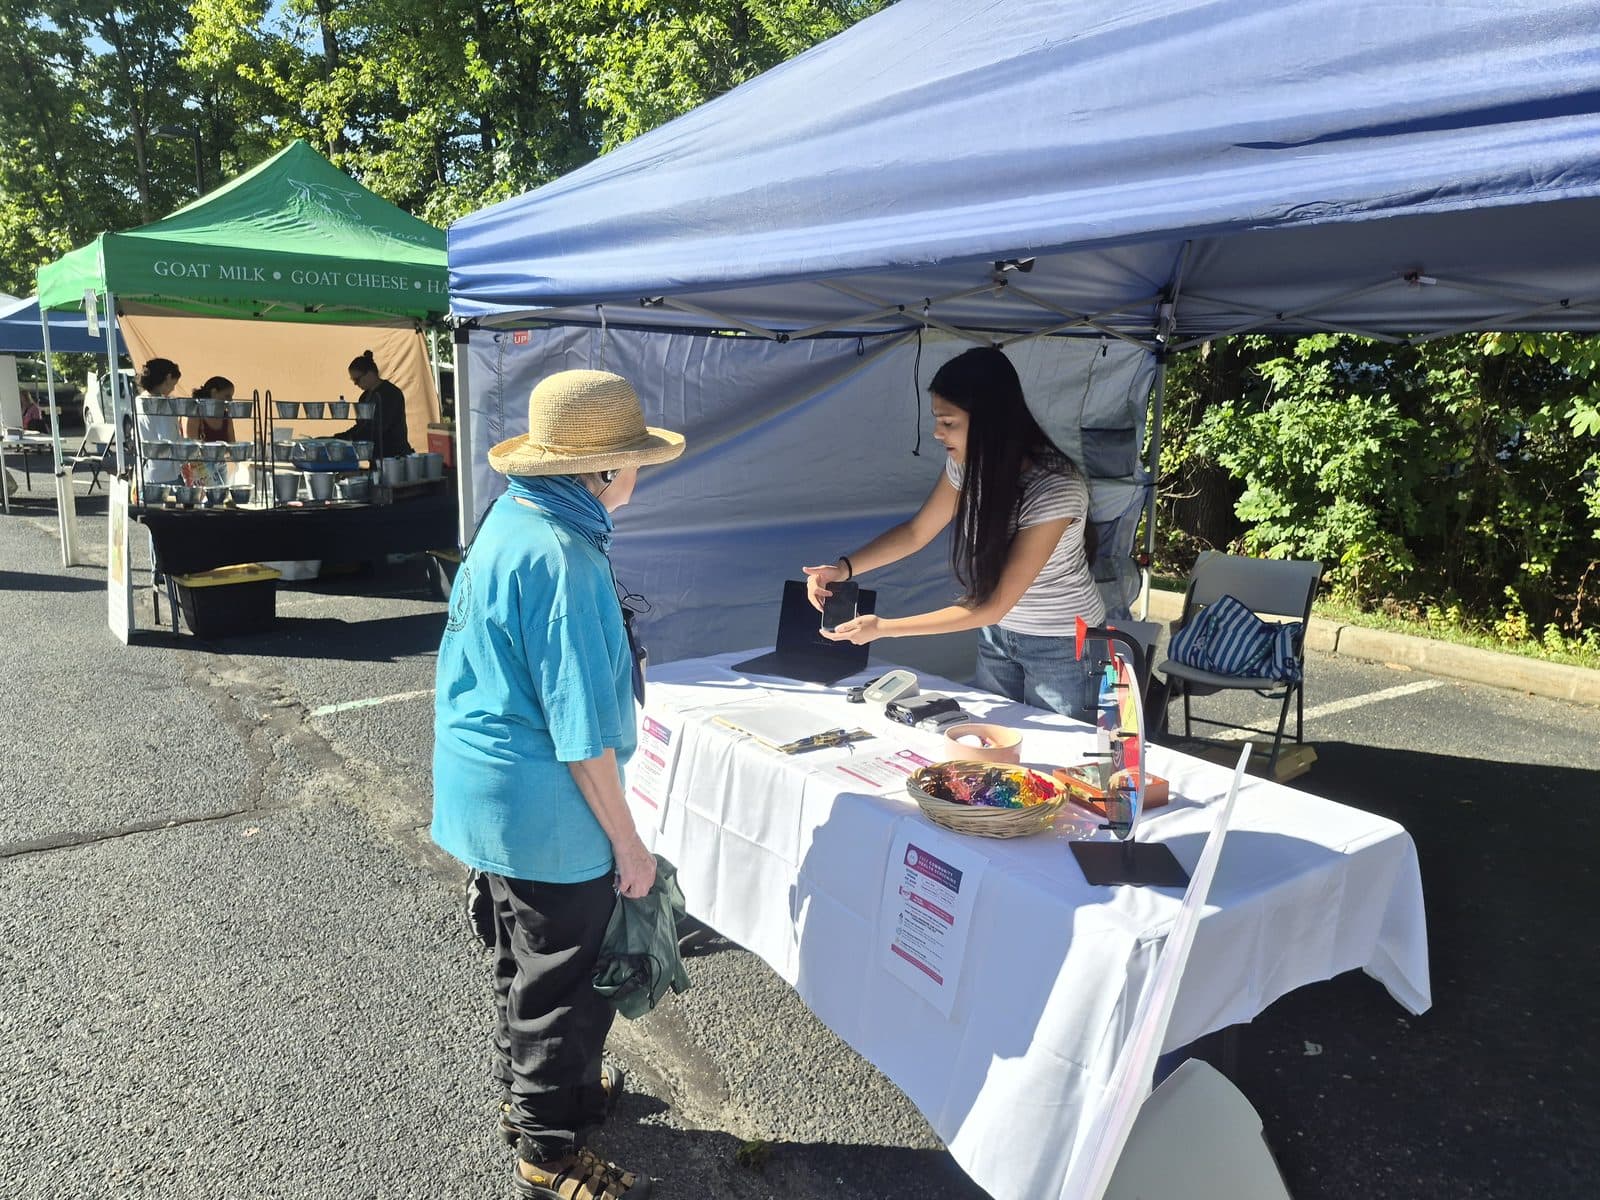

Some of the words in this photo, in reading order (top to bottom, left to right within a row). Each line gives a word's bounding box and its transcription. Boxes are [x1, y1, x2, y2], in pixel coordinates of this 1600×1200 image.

[153, 261, 211, 279] GOAT
[218, 264, 265, 282] MILK
[291, 270, 341, 288] GOAT
[345, 273, 409, 291] CHEESE
